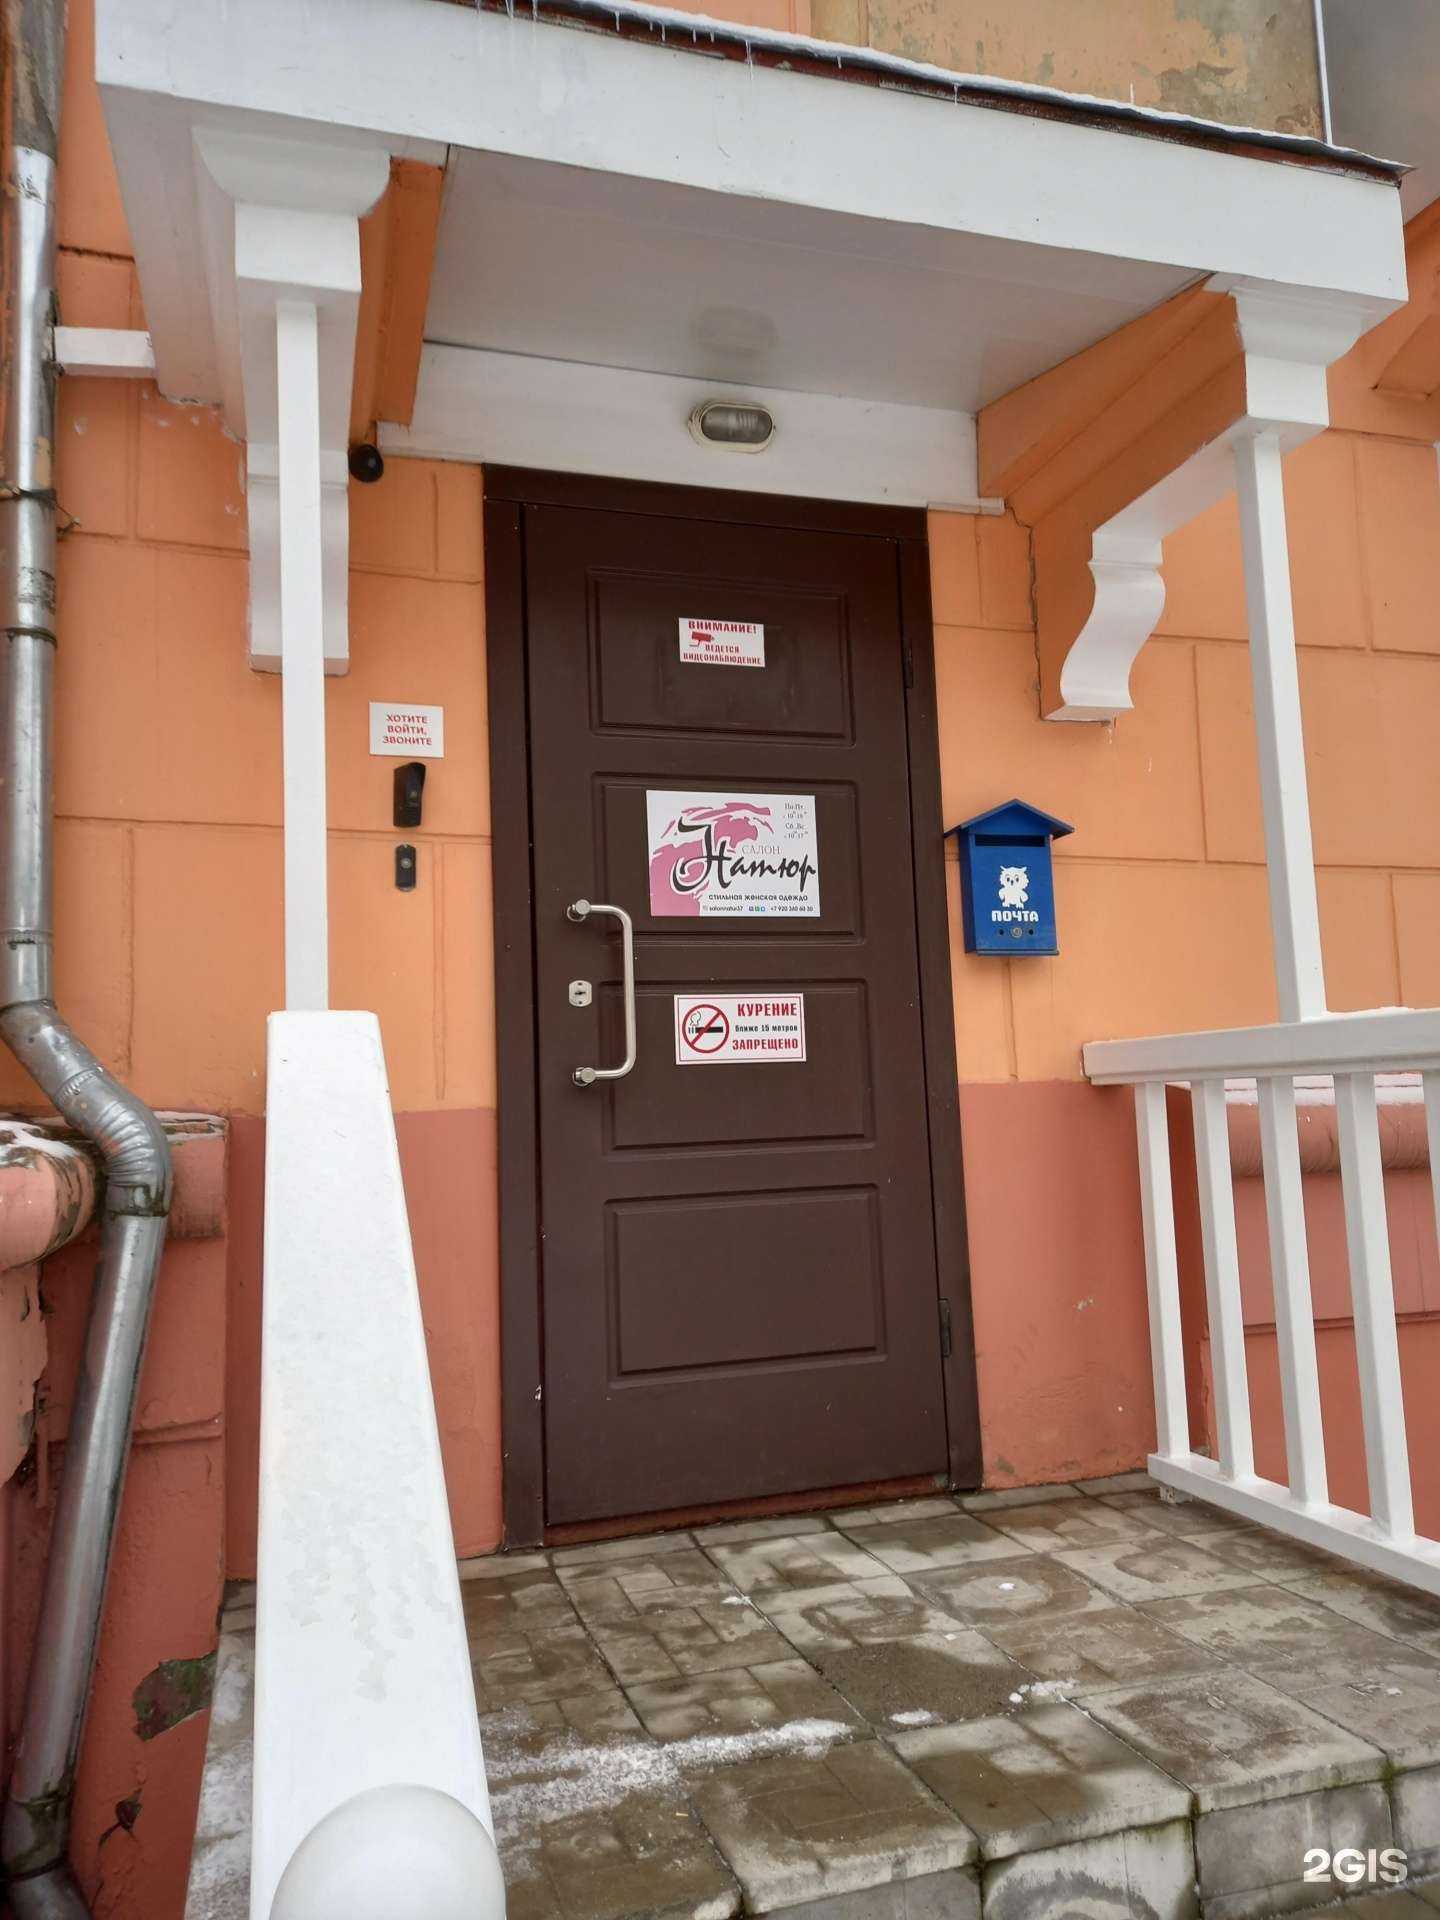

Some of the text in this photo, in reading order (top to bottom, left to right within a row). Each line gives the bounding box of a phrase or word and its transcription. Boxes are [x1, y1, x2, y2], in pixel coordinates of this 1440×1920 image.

[688, 620, 757, 634] ВНИМАНИЕ!
[683, 652, 761, 665] ВИДЕОНАБЛЮДЕНИЕ
[386, 714, 428, 724] ХОТИТЕ
[387, 724, 427, 735] ВОЙТИ,
[382, 735, 432, 746] ЗВОНИТЕ
[741, 844, 781, 855] САЛОН
[991, 910, 1039, 922] ПОЧТА
[737, 1003, 798, 1017] КУРЕНИЕ
[735, 1024, 759, 1032] ближе
[761, 1024, 770, 1032] 15
[732, 1038, 799, 1051] ЗАПРЕЩЕНО
